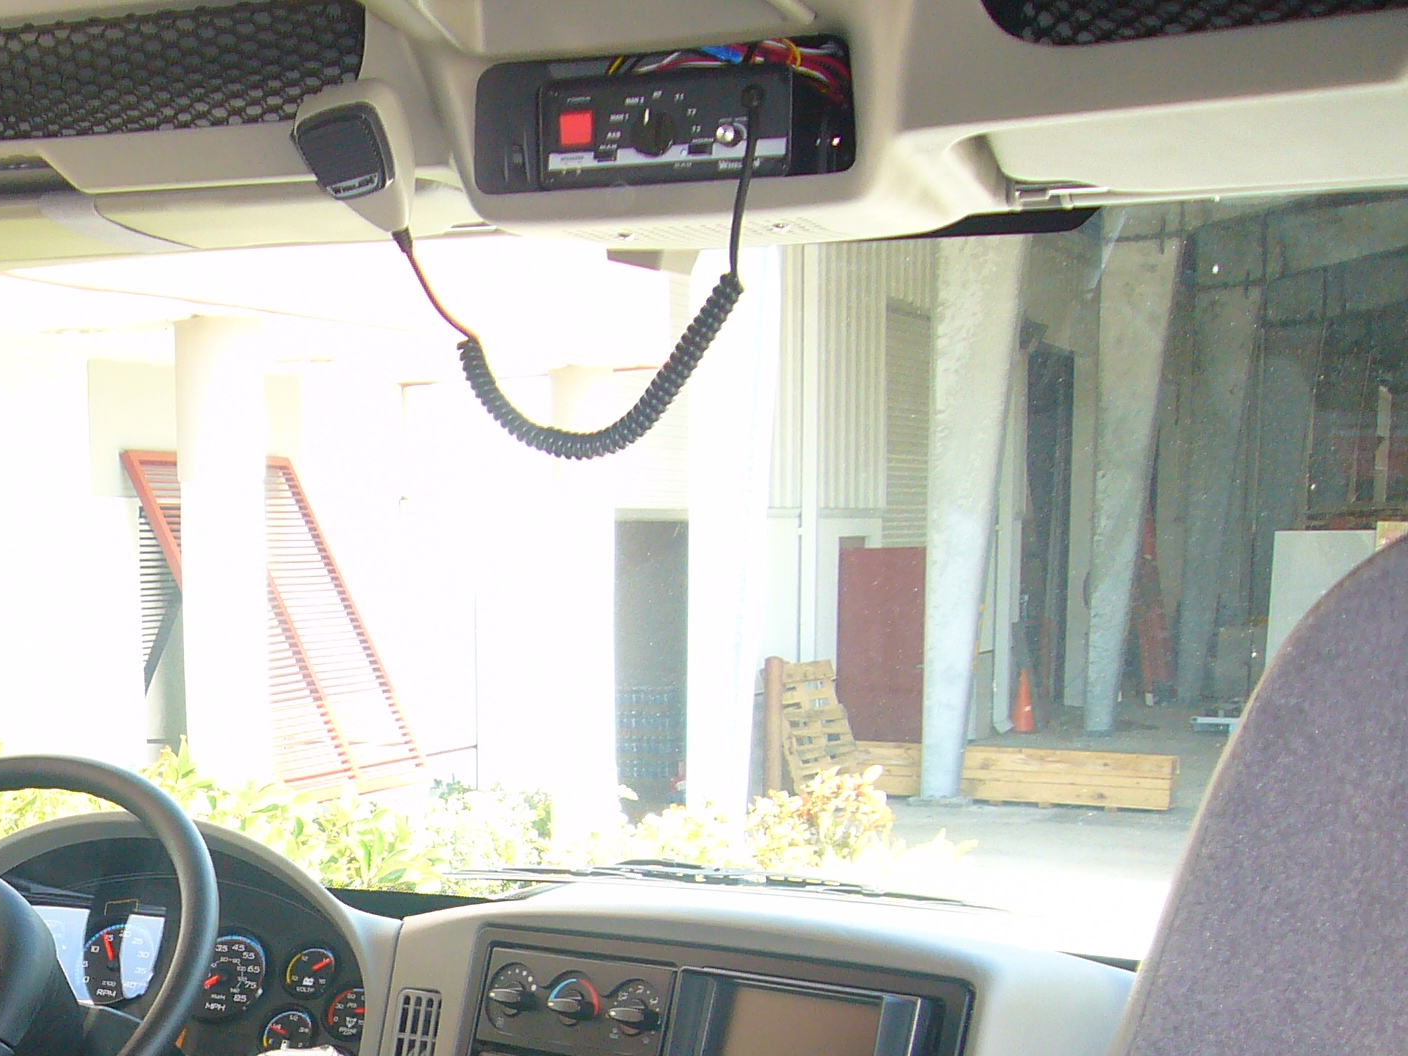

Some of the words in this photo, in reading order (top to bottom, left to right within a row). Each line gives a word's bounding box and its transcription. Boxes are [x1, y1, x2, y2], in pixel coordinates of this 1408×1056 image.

[247, 965, 260, 973] 65
[96, 988, 117, 997] RPM
[205, 1002, 226, 1011] MPH
